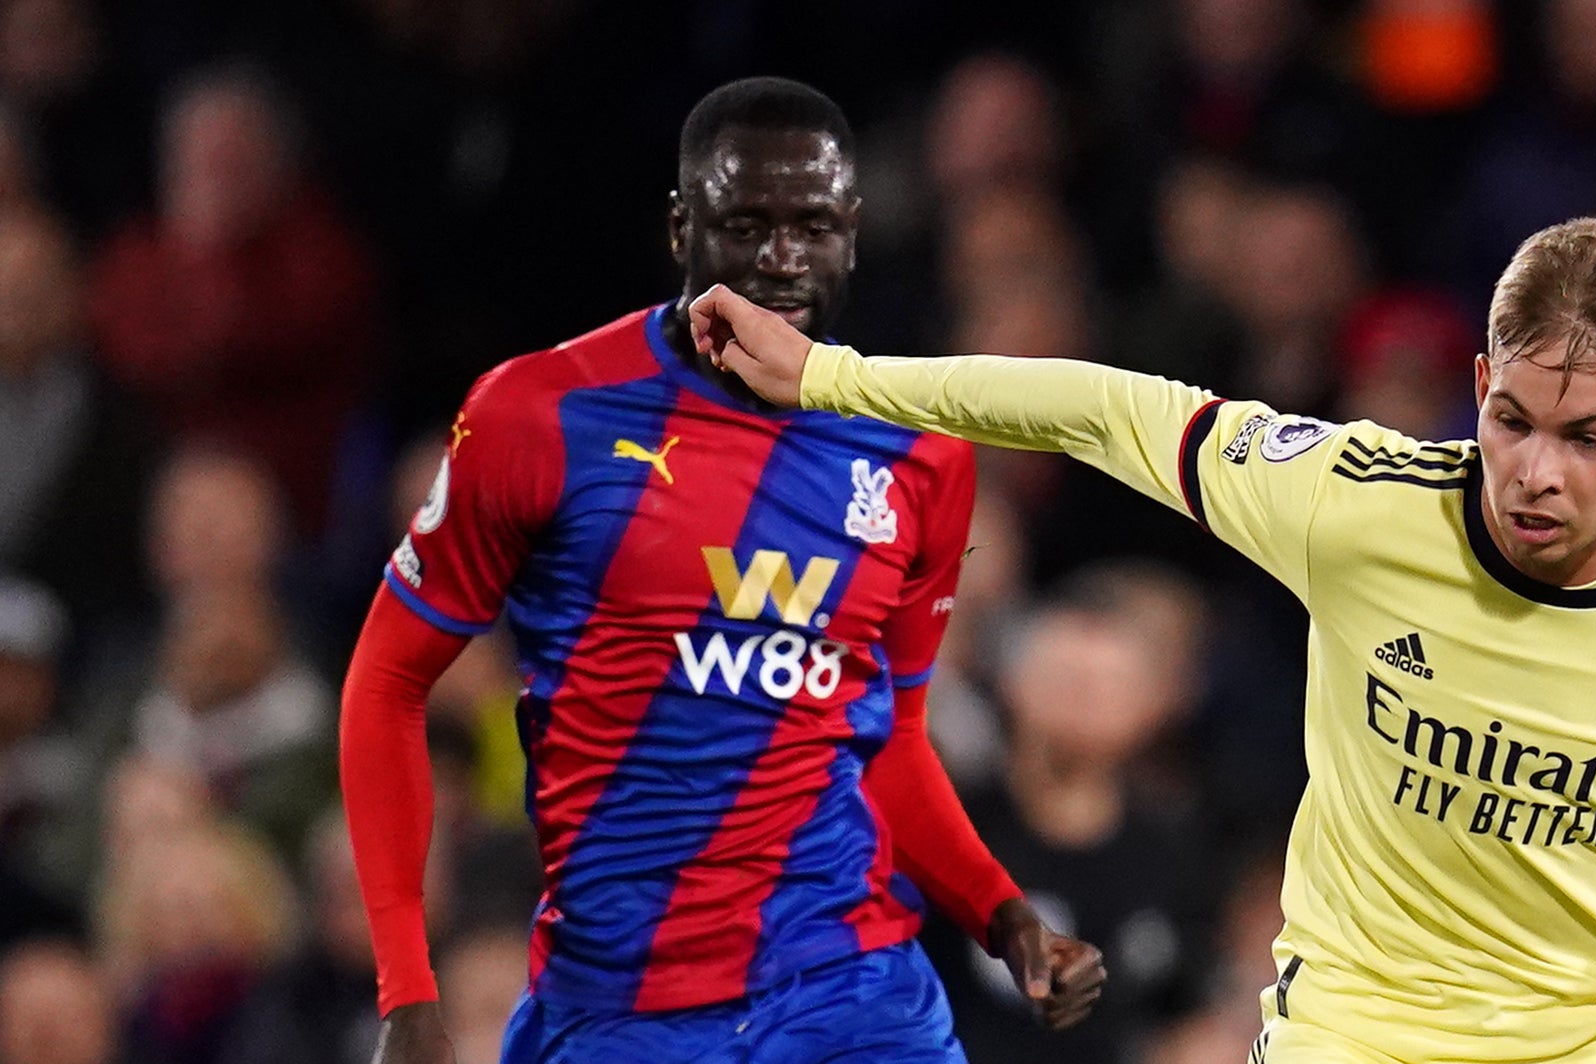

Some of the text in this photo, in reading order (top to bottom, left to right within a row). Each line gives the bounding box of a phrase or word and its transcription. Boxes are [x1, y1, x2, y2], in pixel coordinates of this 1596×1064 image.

[673, 629, 849, 699] W88
[1374, 646, 1434, 681] adidas
[1393, 765, 1461, 823] FLY
